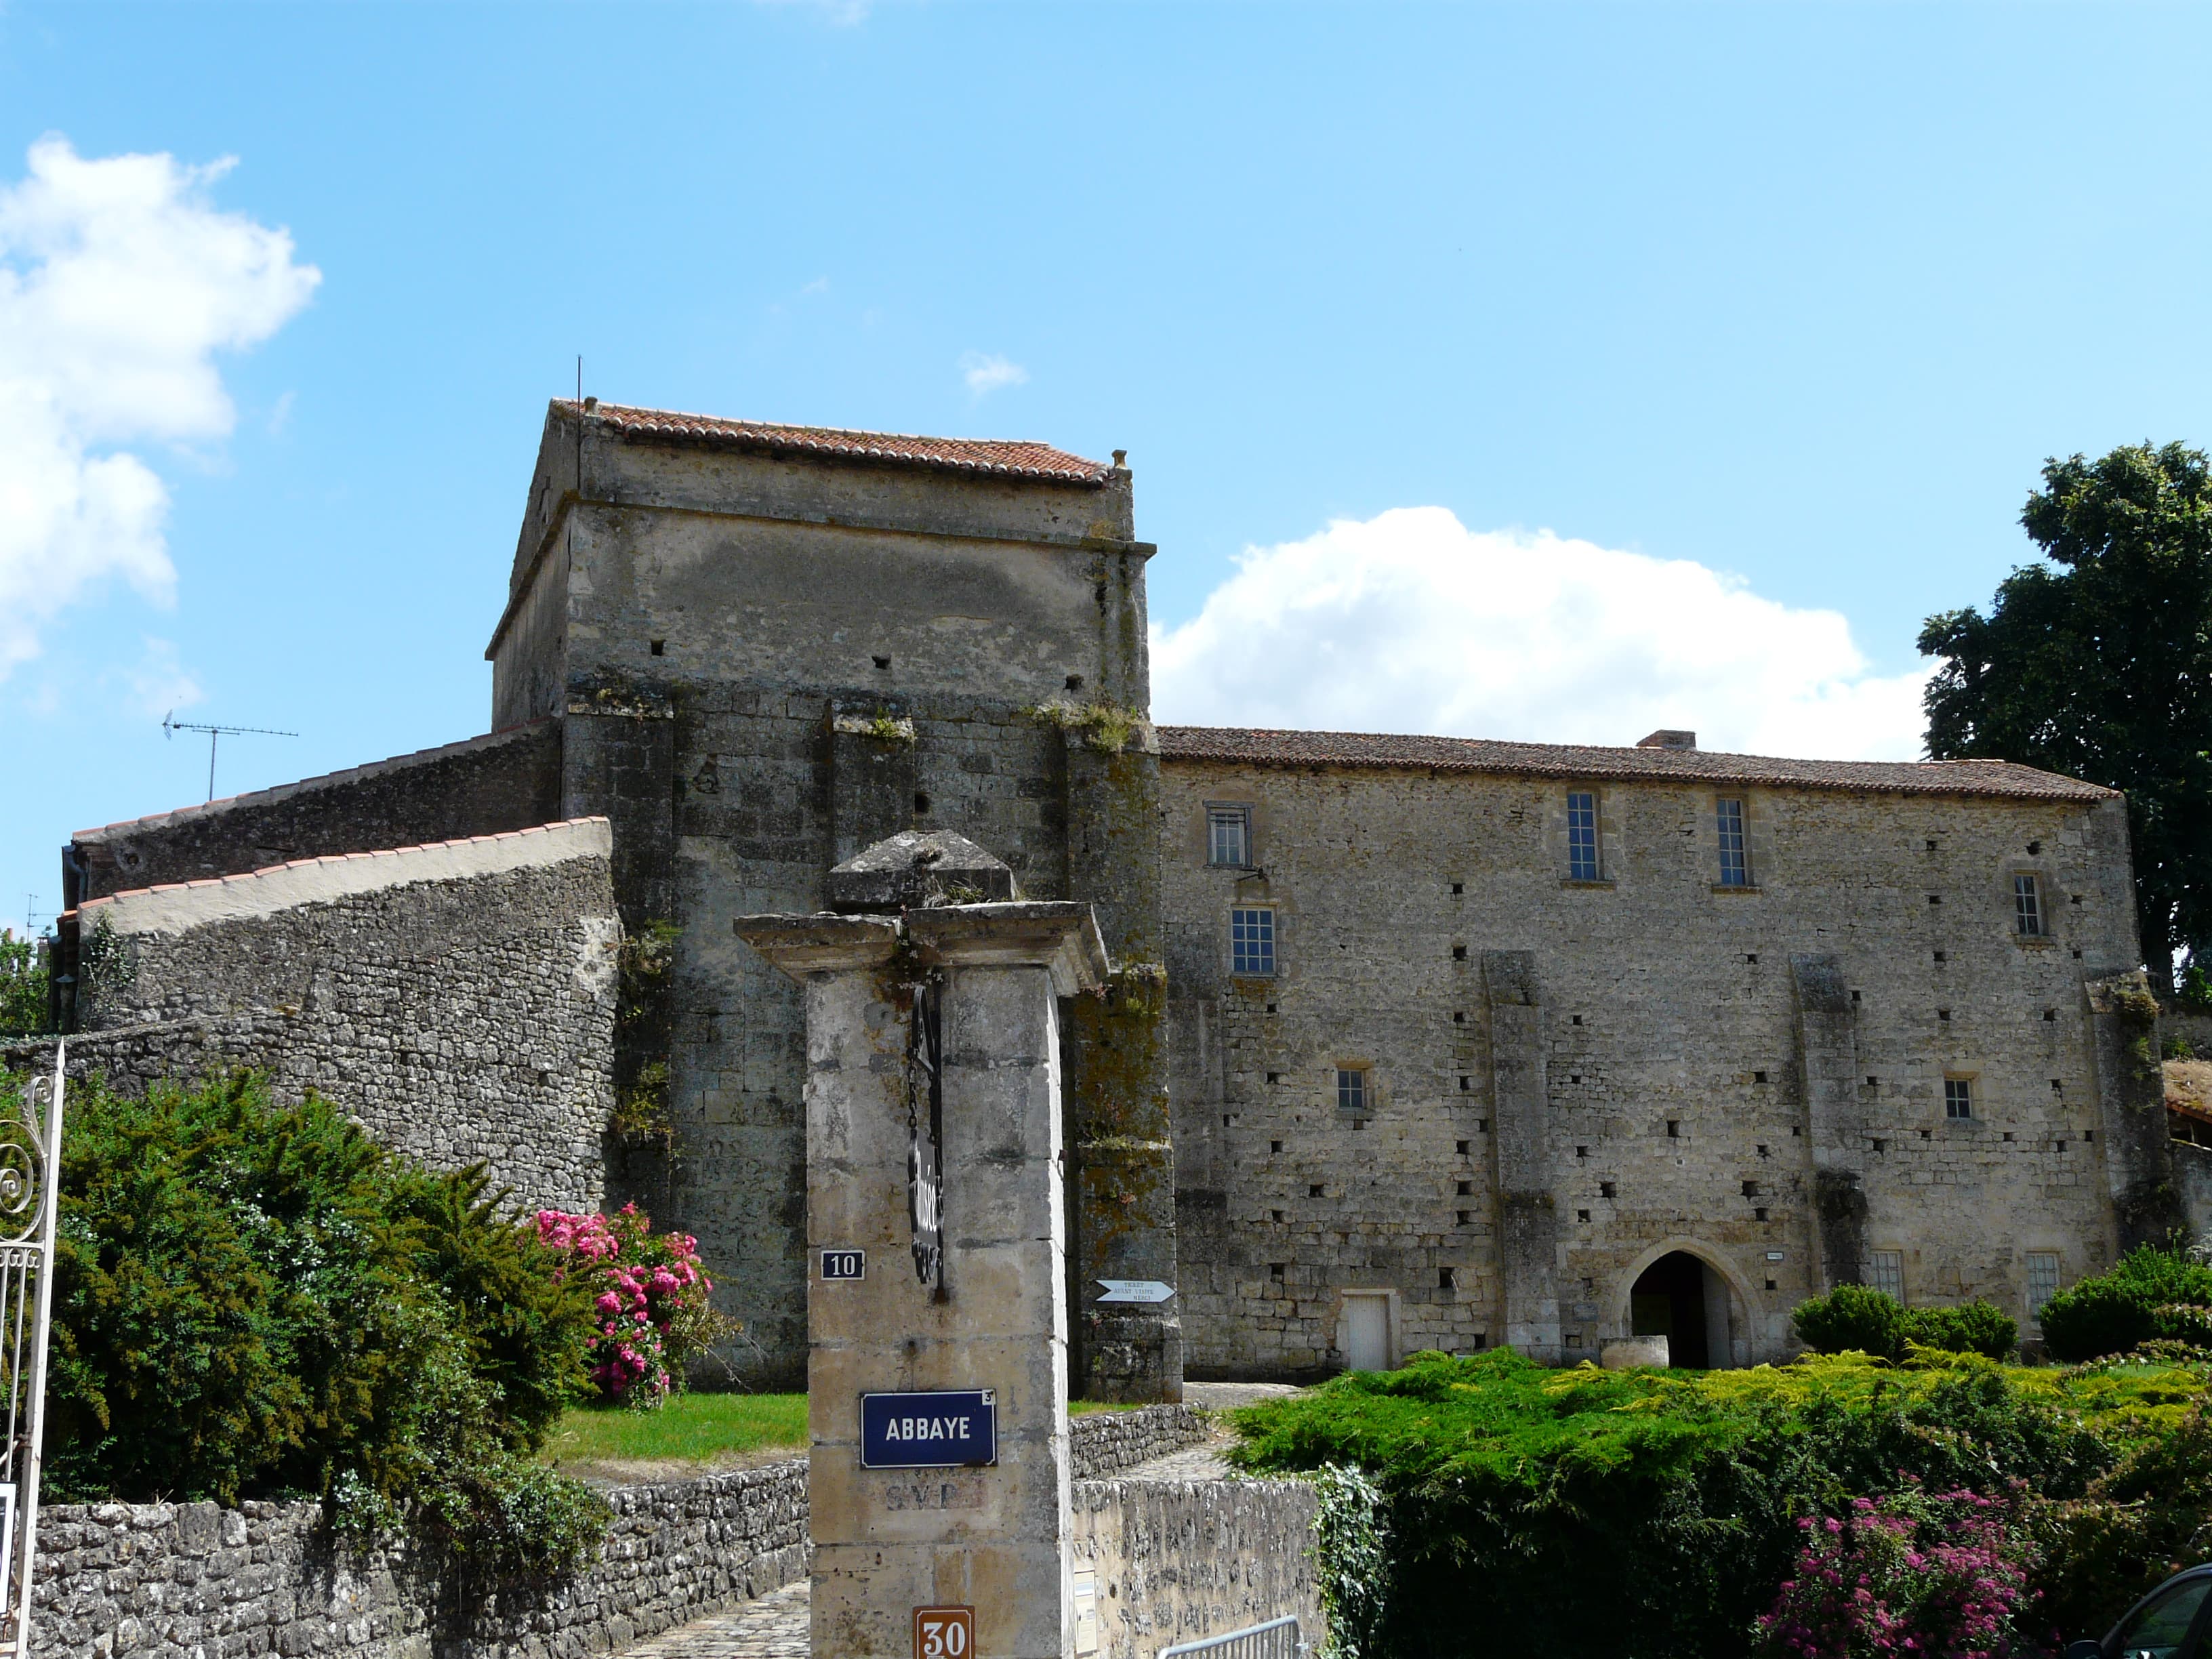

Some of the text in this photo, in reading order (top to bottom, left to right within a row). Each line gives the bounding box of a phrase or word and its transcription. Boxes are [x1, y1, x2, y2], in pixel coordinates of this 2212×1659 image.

[830, 1255, 856, 1275] 10
[985, 1392, 991, 1401] 3
[886, 1417, 970, 1441] ABBAYE
[924, 1622, 965, 1656] 30
